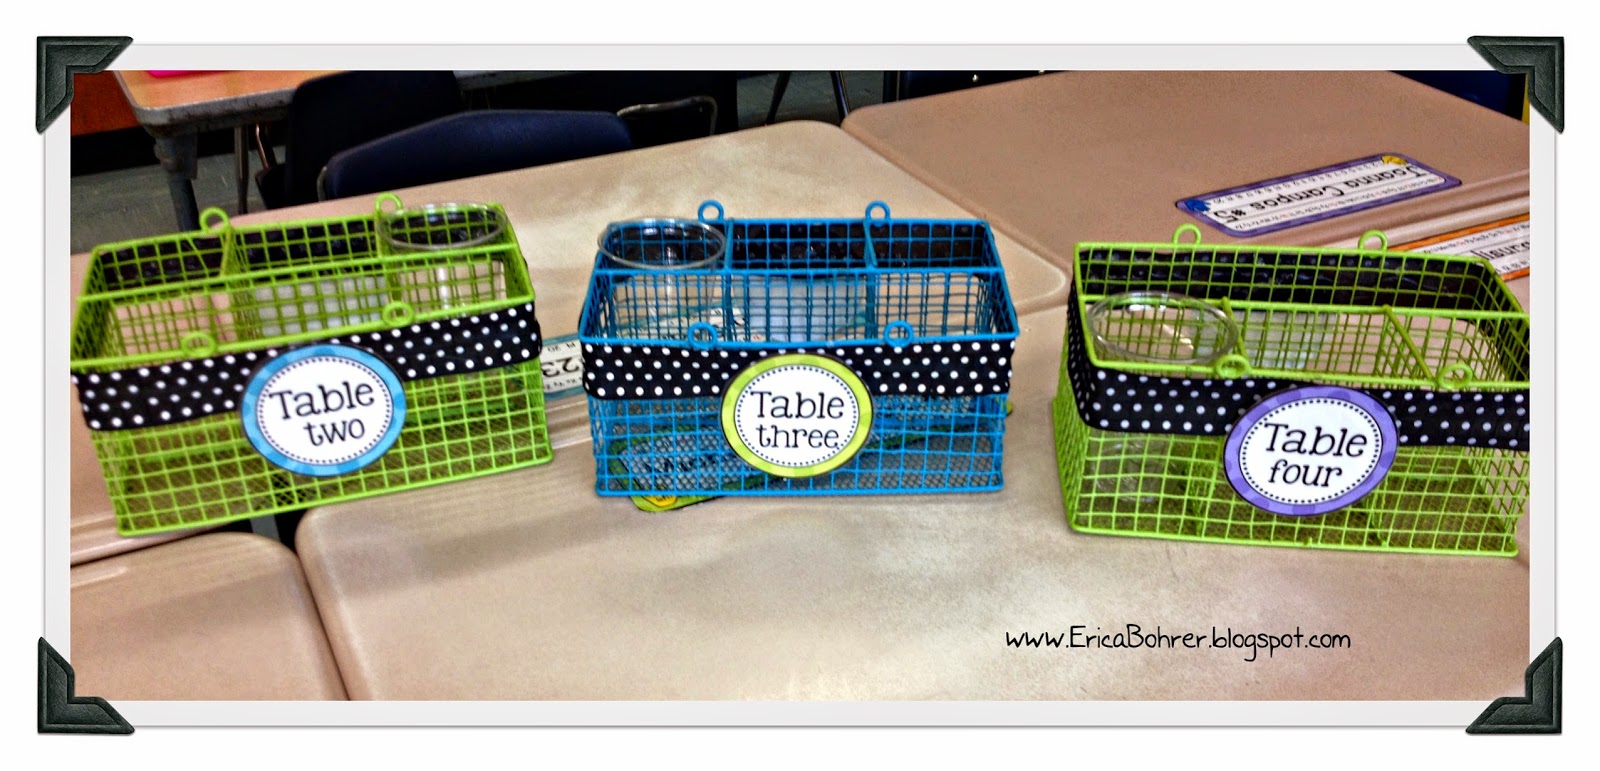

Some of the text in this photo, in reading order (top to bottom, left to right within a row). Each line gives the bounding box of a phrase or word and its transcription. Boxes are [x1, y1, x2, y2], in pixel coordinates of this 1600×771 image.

[1344, 165, 1427, 188] Joanna
[1249, 185, 1345, 210] Campos
[1213, 209, 1247, 224] #5
[268, 381, 375, 420] Table
[750, 391, 845, 419] Table
[303, 418, 366, 447] two
[755, 424, 840, 449] three
[1263, 422, 1368, 457] Table
[1268, 459, 1343, 488] four
